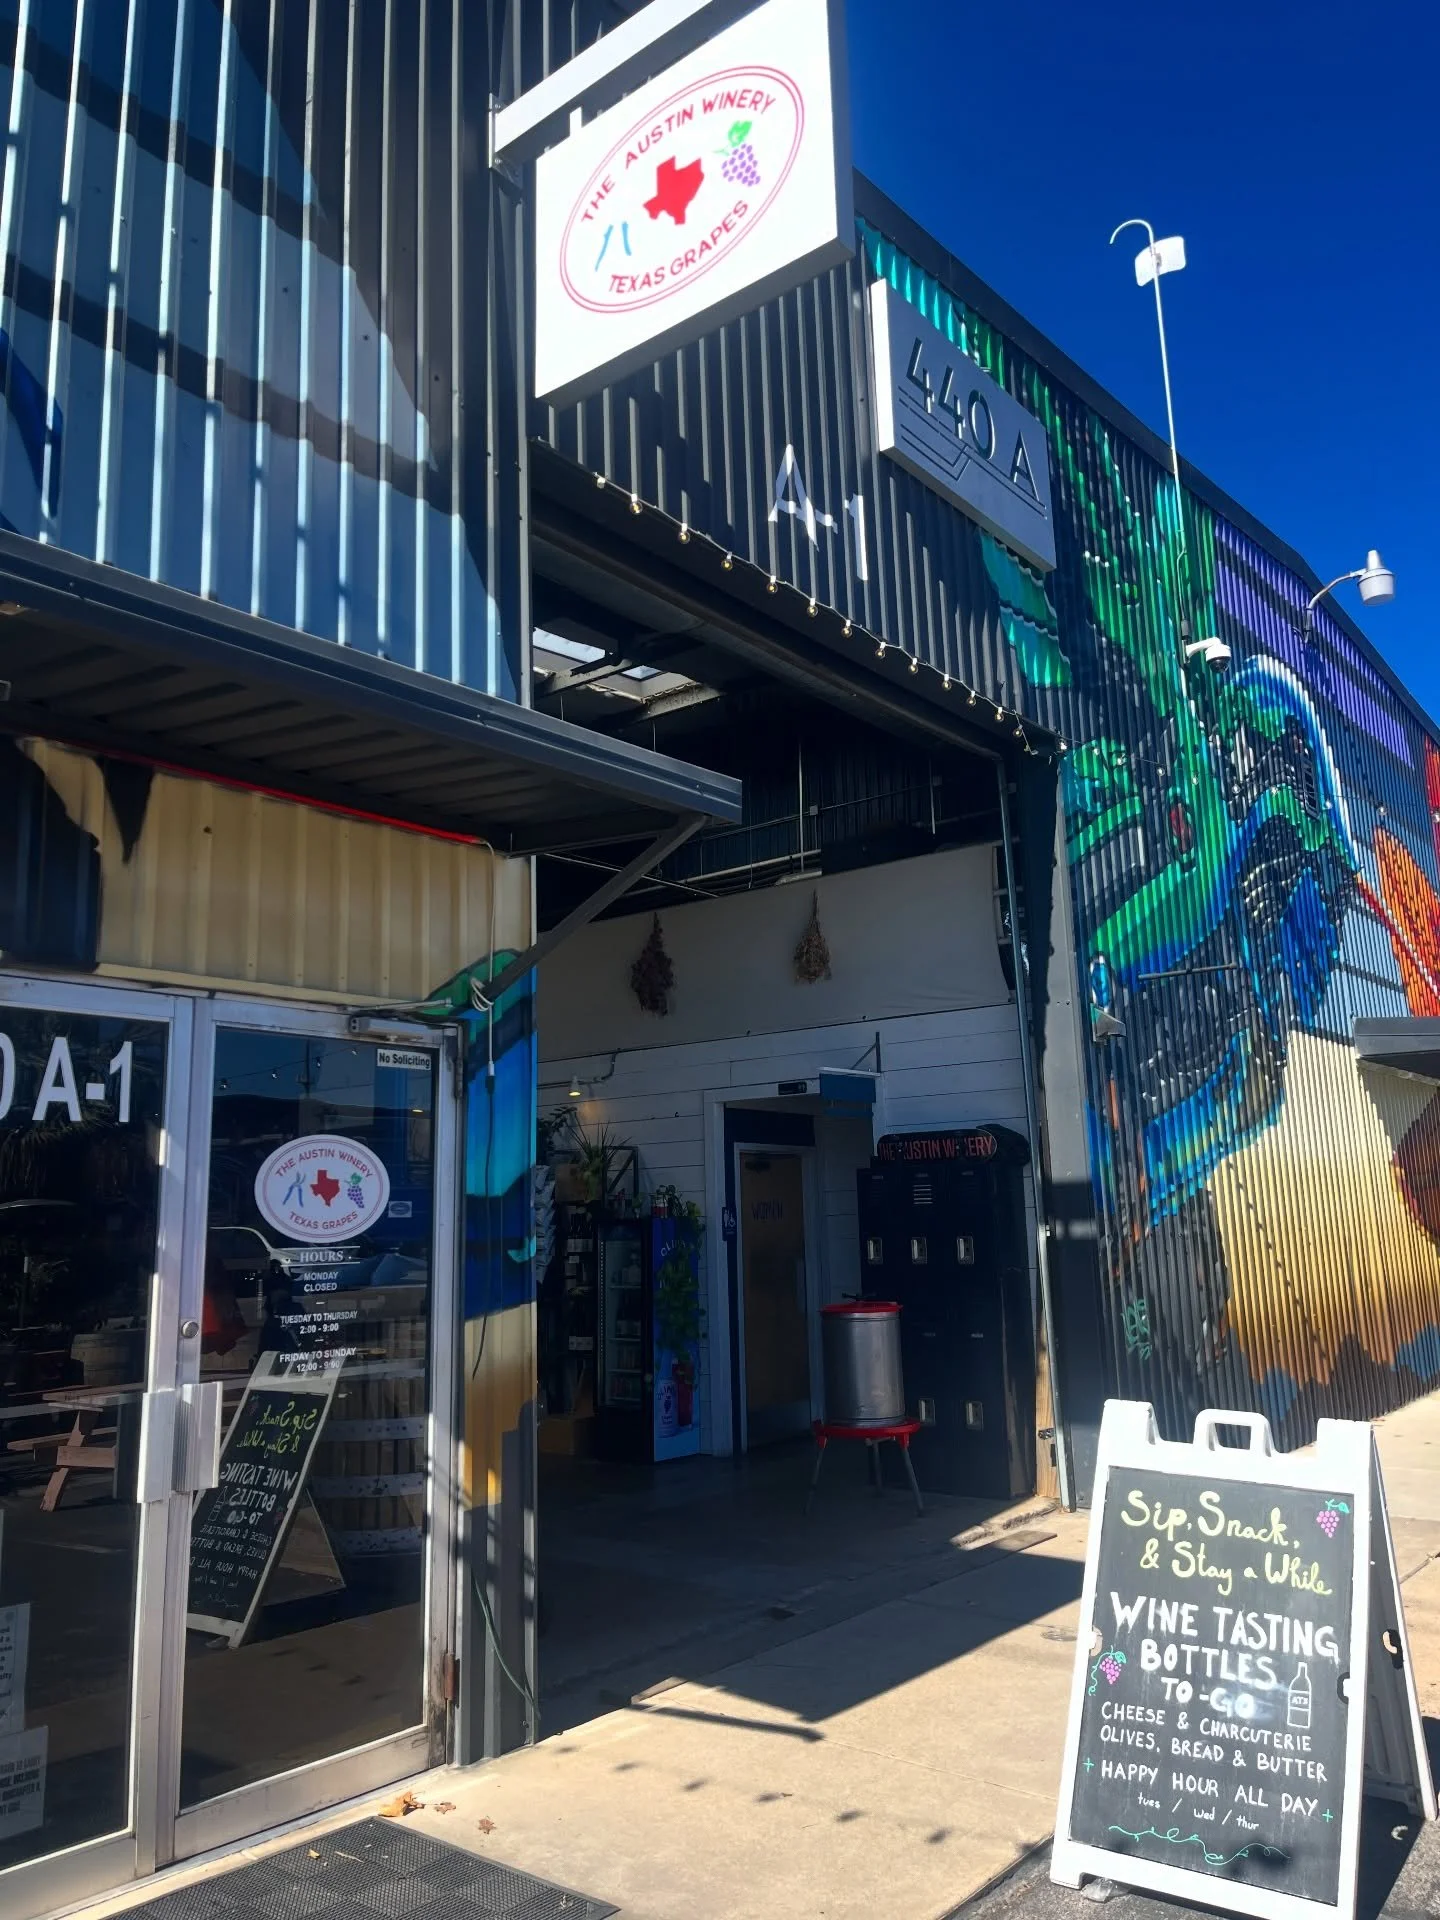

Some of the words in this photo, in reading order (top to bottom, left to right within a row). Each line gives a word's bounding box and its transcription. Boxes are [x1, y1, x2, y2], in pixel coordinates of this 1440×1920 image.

[581, 175, 616, 223] THE
[624, 104, 694, 169] AUSTIN
[701, 88, 776, 114] WINERY
[608, 266, 665, 294] TEXAS
[669, 200, 749, 276] GRAPES
[906, 336, 996, 461] 440
[1009, 429, 1040, 501] A
[767, 443, 869, 581] A-1
[31, 1036, 133, 1123] A-1
[378, 1052, 391, 1064] No
[392, 1053, 431, 1069] Soliciting
[275, 1158, 297, 1177] THE
[298, 1148, 336, 1162] AUSTIN
[339, 1150, 374, 1178] WINERY
[289, 1211, 319, 1230] TEXAS
[322, 1211, 359, 1230] GRAPES
[300, 1250, 344, 1263] HOURS
[303, 1271, 339, 1281] MONDAY
[303, 1282, 338, 1292] CLOSED
[280, 1314, 312, 1325] TUESDAY
[312, 1313, 323, 1322] TO
[323, 1310, 359, 1321] THURSDAY
[300, 1325, 317, 1334] 2:00
[322, 1323, 340, 1333] 9:00
[280, 1351, 310, 1362] FRIDAY
[311, 1350, 323, 1359] TO
[323, 1347, 357, 1359] SUNDAY
[296, 1362, 317, 1373] 12:00
[1121, 1490, 1192, 1541] Sip,
[1198, 1490, 1300, 1549] Snack,
[1140, 1537, 1160, 1569] &
[1171, 1541, 1233, 1596] Stay
[1243, 1566, 1258, 1579] a
[1264, 1551, 1333, 1595] While
[1109, 1591, 1199, 1637] WINE
[1212, 1606, 1339, 1664] TASTING
[1140, 1638, 1278, 1690] BOTTLES
[1101, 1701, 1166, 1726] CHEESE
[1176, 1711, 1190, 1730] &
[1200, 1717, 1312, 1751] CHARCUTERIE
[1100, 1724, 1160, 1752] OLIVES,
[1171, 1737, 1224, 1762] BREAD
[1232, 1749, 1247, 1767] &
[1256, 1752, 1328, 1782] BUTTER
[1101, 1760, 1159, 1785] HAPPY
[1172, 1772, 1219, 1797] HOUR
[1234, 1785, 1269, 1808] ALL
[1281, 1793, 1319, 1817] DAY
[1137, 1792, 1161, 1809] tues
[1236, 1815, 1260, 1831] thur
